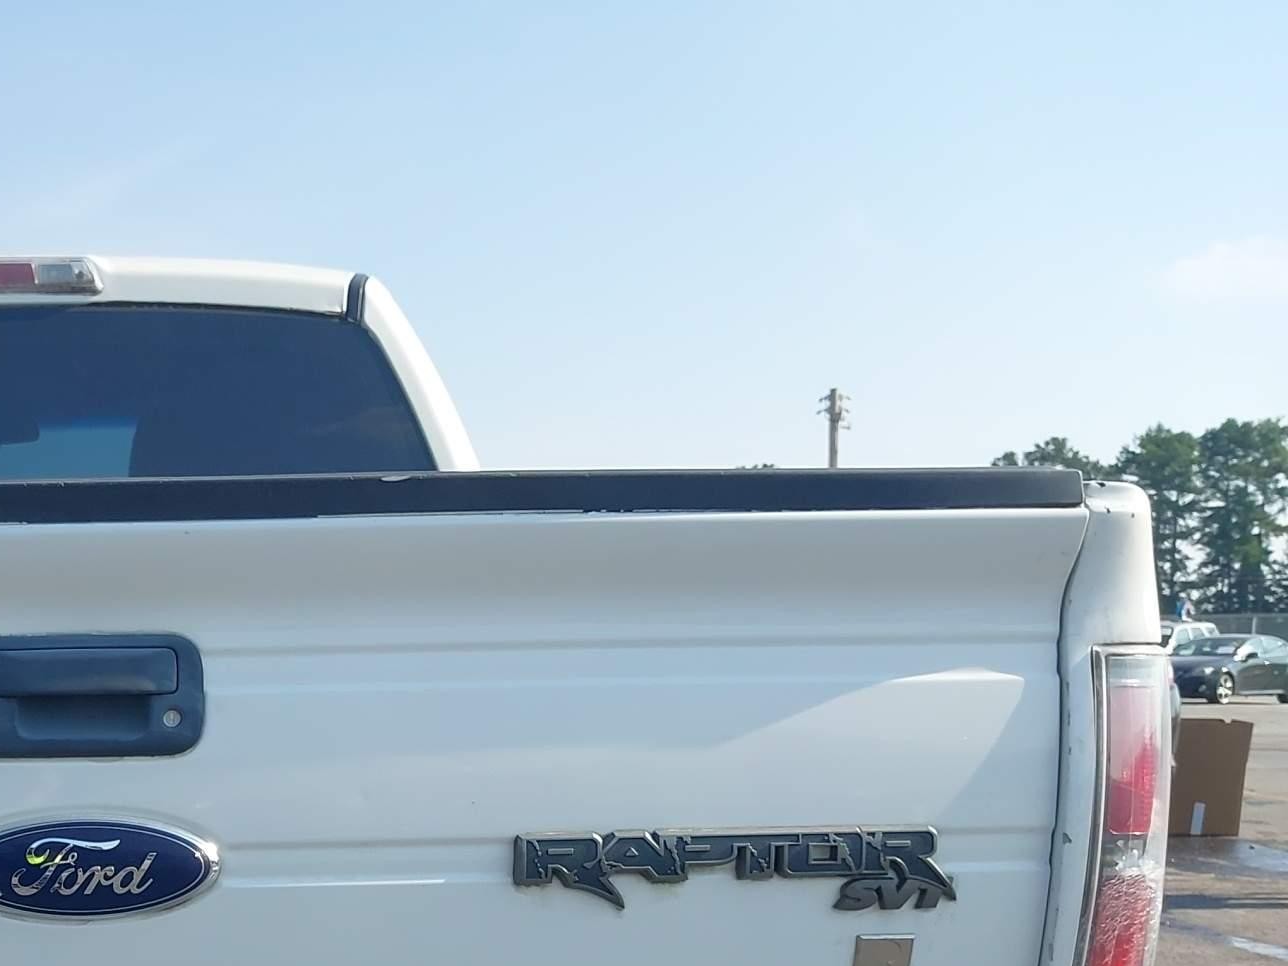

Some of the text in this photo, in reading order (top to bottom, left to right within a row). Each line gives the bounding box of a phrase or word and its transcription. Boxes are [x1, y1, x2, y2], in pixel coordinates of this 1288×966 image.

[11, 837, 158, 897] Ford
[513, 826, 956, 910] RAPTOR
[832, 876, 954, 911] SVT
